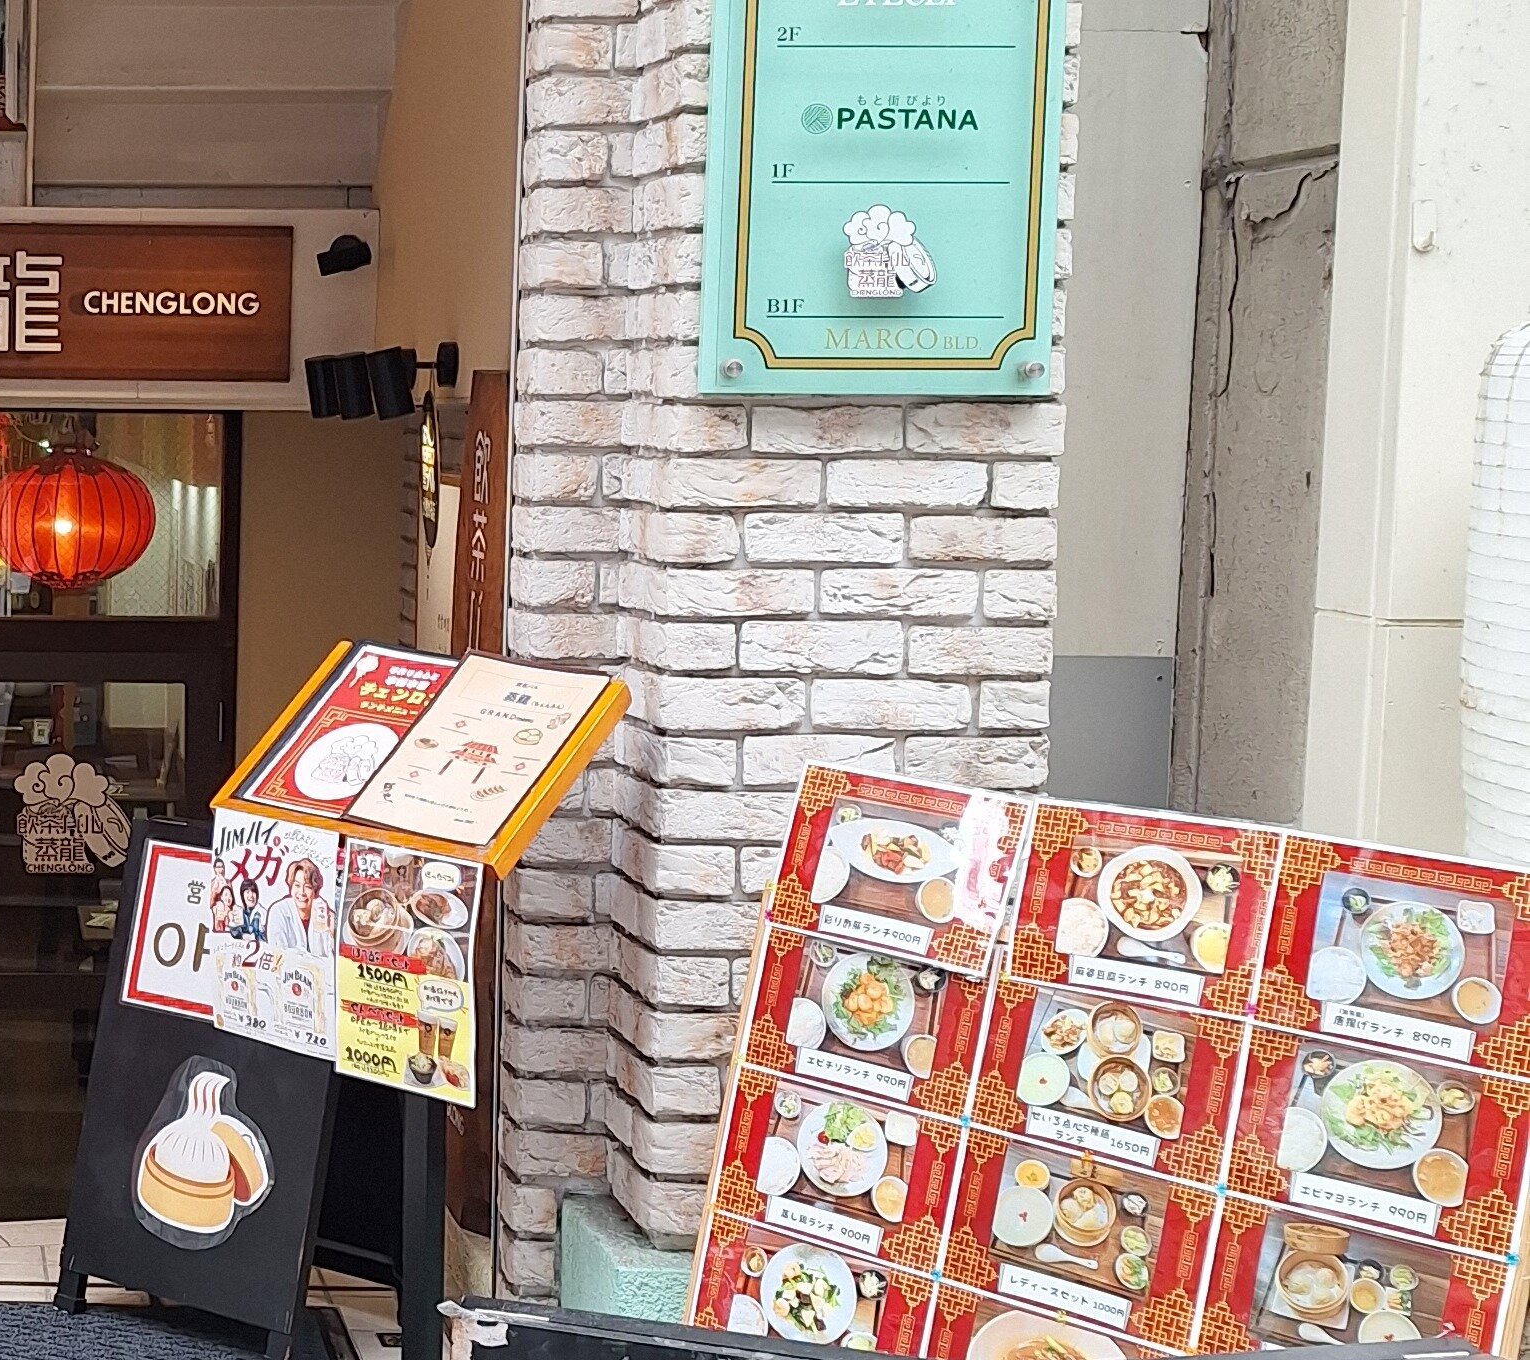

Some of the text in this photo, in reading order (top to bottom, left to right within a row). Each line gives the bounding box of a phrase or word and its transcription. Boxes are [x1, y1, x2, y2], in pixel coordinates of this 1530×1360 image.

[777, 26, 802, 42] 2F
[857, 94, 946, 107] もと街びより
[836, 107, 979, 131] PASTANA
[772, 163, 795, 179] 1F
[82, 291, 261, 317] CHENGLONG
[767, 299, 805, 314] B1F
[824, 327, 981, 350] MARCO BLD.
[34, 837, 85, 862] 蒸龍
[27, 863, 95, 873] CHENGLONG
[229, 844, 290, 887] メガ
[187, 880, 206, 905] 営
[357, 963, 409, 990] 1500円
[1154, 978, 1190, 994] 890円
[283, 1003, 313, 1019] BOURBON
[1333, 1015, 1452, 1048] 唐揚げランチ 890円
[345, 1046, 398, 1073] 1000円
[806, 1056, 907, 1089] エビチリランチ 990円
[1054, 1129, 1151, 1156] ランチ 1650円
[1299, 1185, 1427, 1224] エビマヨランチ 990円
[840, 1227, 871, 1244] 900円
[1010, 1275, 1125, 1317] レディースセット 1000円
